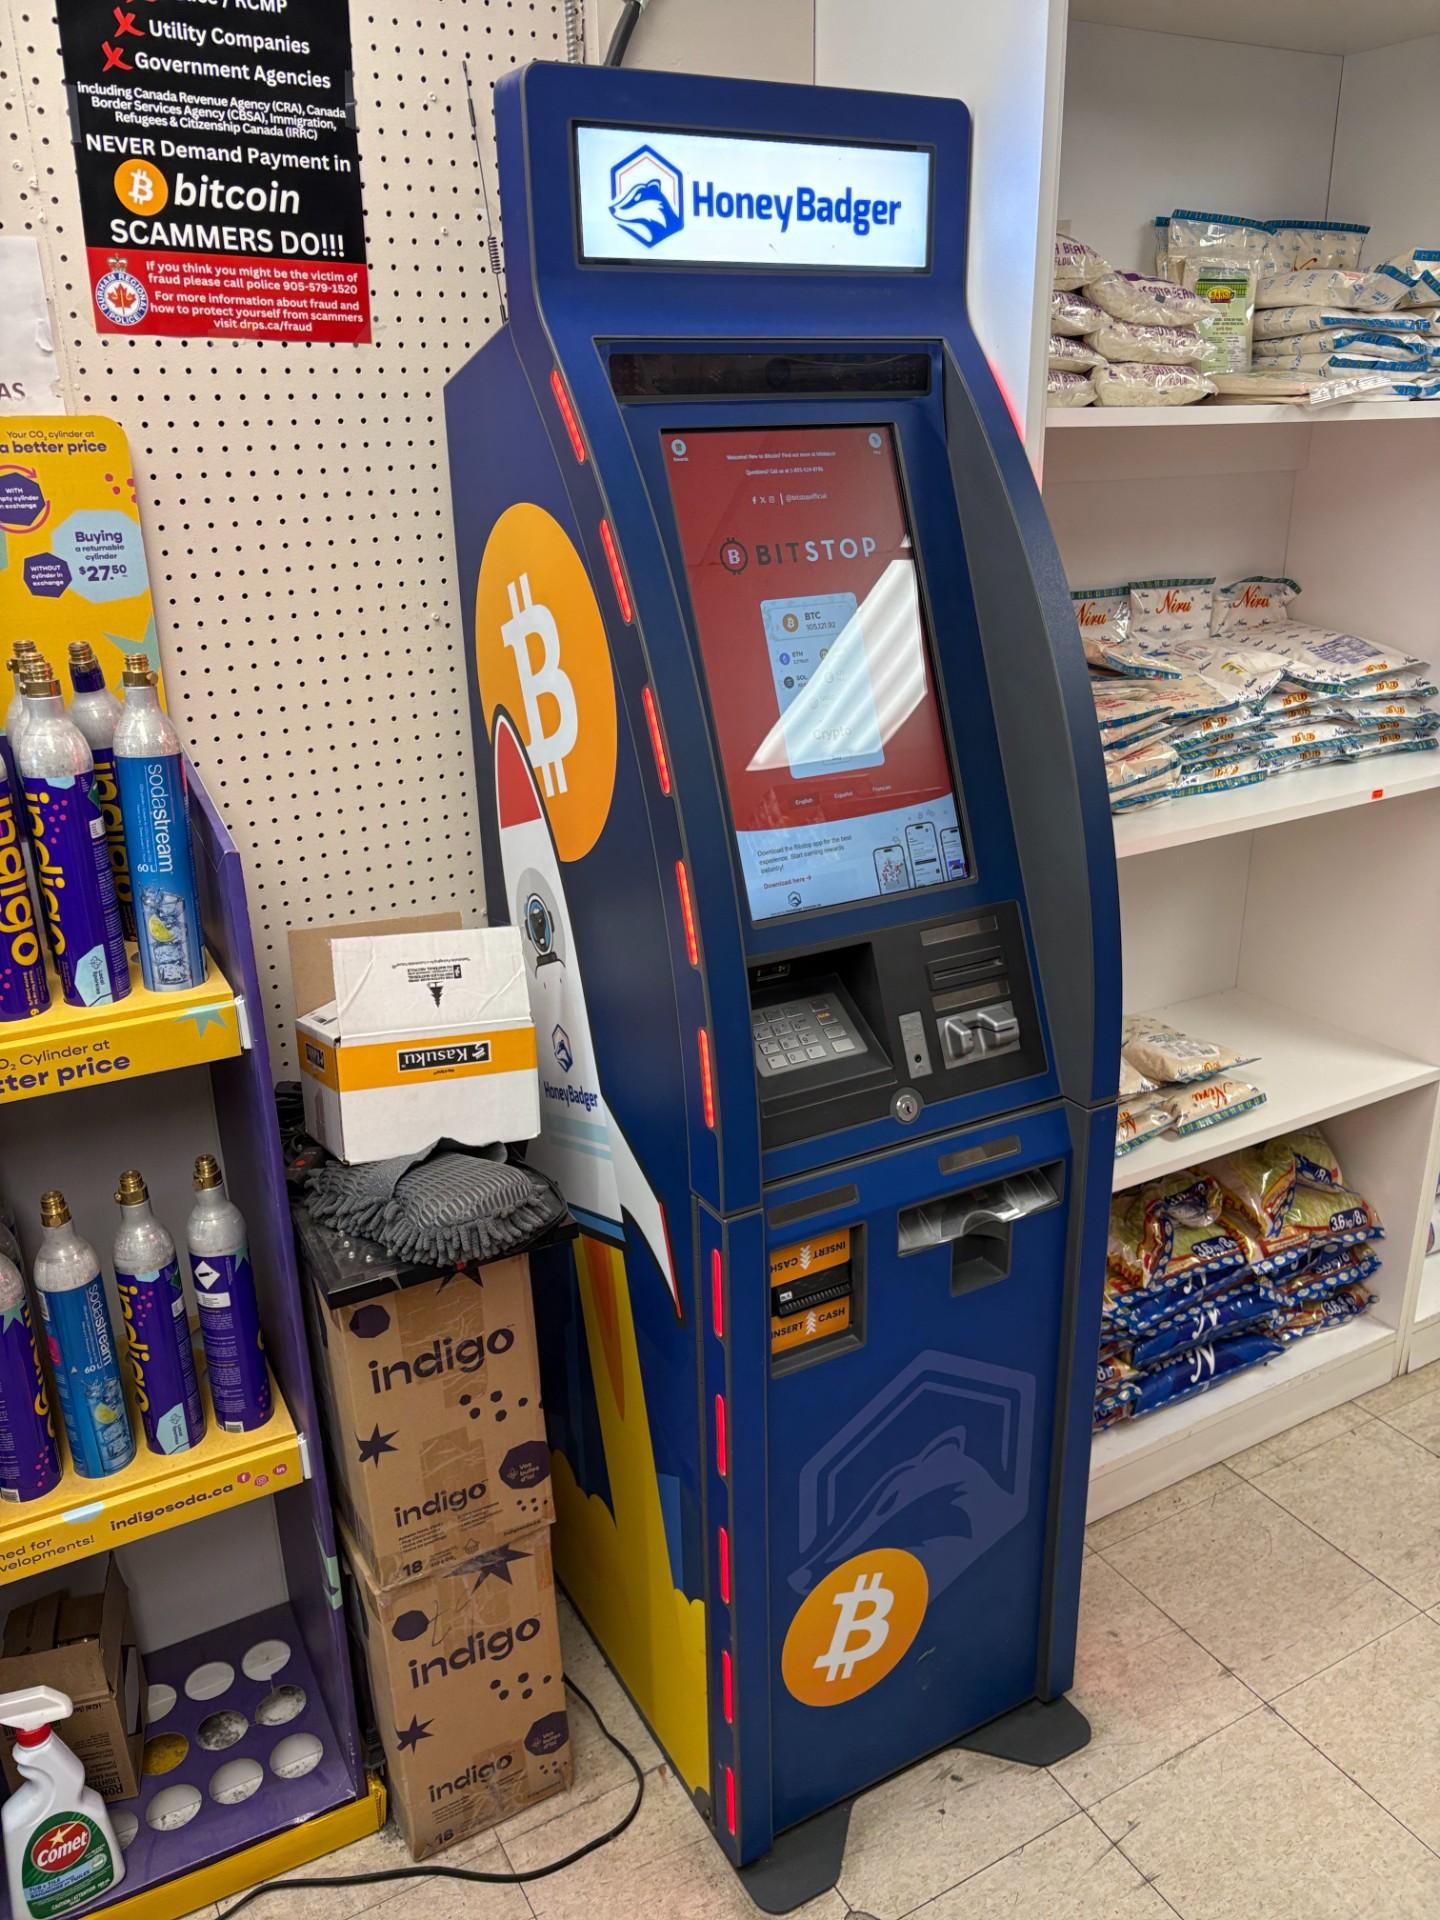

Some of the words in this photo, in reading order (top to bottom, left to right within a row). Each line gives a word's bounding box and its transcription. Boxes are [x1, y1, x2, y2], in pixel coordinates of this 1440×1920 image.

[149, 20, 206, 46] Utility
[211, 28, 310, 54] Companies
[135, 52, 250, 80] Government
[254, 66, 332, 88] Agencies
[77, 81, 132, 100] including
[134, 88, 177, 102] Canada
[179, 92, 228, 107] Revenue
[230, 97, 270, 113] Agency
[272, 101, 306, 116] (CRA),
[306, 104, 346, 118] Canada
[91, 96, 132, 108] Border
[134, 100, 182, 115] Services
[184, 105, 225, 122] Agency
[227, 108, 268, 125] (CBSA),
[270, 113, 336, 132] Immigration,
[115, 111, 168, 127] Refugees
[170, 116, 178, 127] &
[180, 116, 240, 135] Citizenship
[242, 123, 284, 136] Canada
[285, 126, 318, 141] (IRRC)
[86, 134, 156, 156] NEVER
[160, 140, 242, 163] Demand
[248, 148, 330, 171] Payment
[334, 154, 352, 172] in
[174, 172, 300, 214] bitcoin
[692, 180, 902, 235] HoneyBadger
[110, 219, 274, 254] SCAMMERS
[280, 230, 345, 258] DO!!!
[146, 261, 155, 270] If
[158, 263, 180, 273] you
[182, 263, 212, 274] think
[214, 266, 236, 276] you
[239, 266, 272, 280] might
[274, 268, 288, 278] be
[290, 270, 308, 280] the
[311, 271, 344, 282] victim
[346, 272, 358, 283] of
[148, 273, 180, 284] fraud
[183, 275, 220, 287] please
[224, 278, 244, 288] call
[246, 280, 281, 291] police
[283, 281, 358, 294] 905-579-1520
[97, 274, 116, 309] DURHAM
[118, 272, 147, 314] REGIONAL
[155, 291, 173, 301] For
[177, 294, 206, 302] more
[208, 293, 274, 306] information
[276, 297, 308, 308] about
[310, 299, 338, 310] fraud
[340, 301, 359, 310] and
[108, 312, 140, 324] POLICE
[150, 303, 175, 313] how
[177, 304, 189, 314] to
[192, 306, 233, 317] protect
[236, 308, 281, 319] yourself
[283, 309, 308, 319] from
[311, 312, 363, 323] scammers
[214, 318, 238, 328] visit
[240, 319, 312, 332] drps.ca/fraud
[12, 441, 64, 453] better
[67, 439, 107, 455] price
[48, 430, 83, 439] cylinder
[75, 530, 122, 544] Buying
[756, 537, 876, 565] BITSTOP
[1156, 590, 1191, 614] Niru
[1233, 586, 1270, 609] Niru
[804, 612, 821, 620] BTC
[1076, 603, 1106, 627] Niru
[147, 764, 173, 873] sodastream
[764, 880, 792, 889] Download
[20, 1045, 88, 1065] Cylinder
[92, 1040, 110, 1052] at
[404, 1048, 467, 1066] Kasuku
[57, 1056, 130, 1086] price
[544, 1080, 597, 1112] HoneyBadger
[1192, 1082, 1232, 1108] Niru
[813, 1241, 846, 1259] INSERT
[89, 1284, 112, 1366] sodastream
[818, 1307, 846, 1322] CASH
[368, 1328, 515, 1395] indigo
[110, 1483, 233, 1531] indigosoda.ca
[394, 1483, 487, 1528] indigo
[31, 1538, 52, 1552] for
[402, 1560, 423, 1576] 18
[408, 1617, 541, 1689] indigo
[429, 1754, 513, 1802] indigo
[37, 1830, 88, 1867] Comet
